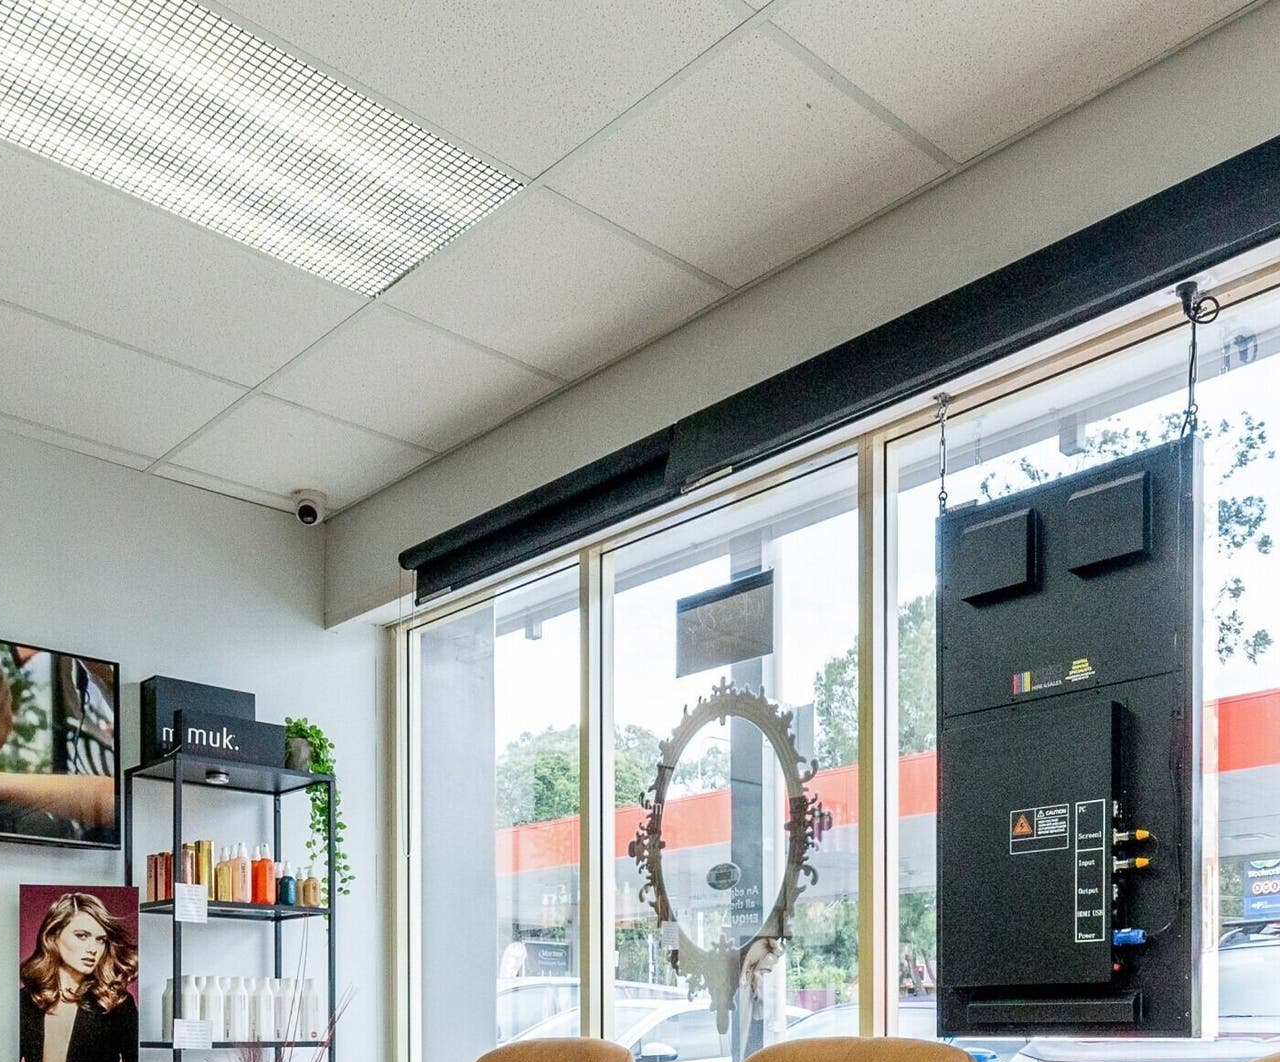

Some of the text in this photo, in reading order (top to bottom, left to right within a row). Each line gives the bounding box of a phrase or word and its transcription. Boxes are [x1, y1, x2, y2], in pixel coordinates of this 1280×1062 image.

[1045, 808, 1067, 816] CAUTION
[1078, 859, 1096, 867] Input
[1078, 887, 1099, 895] Output
